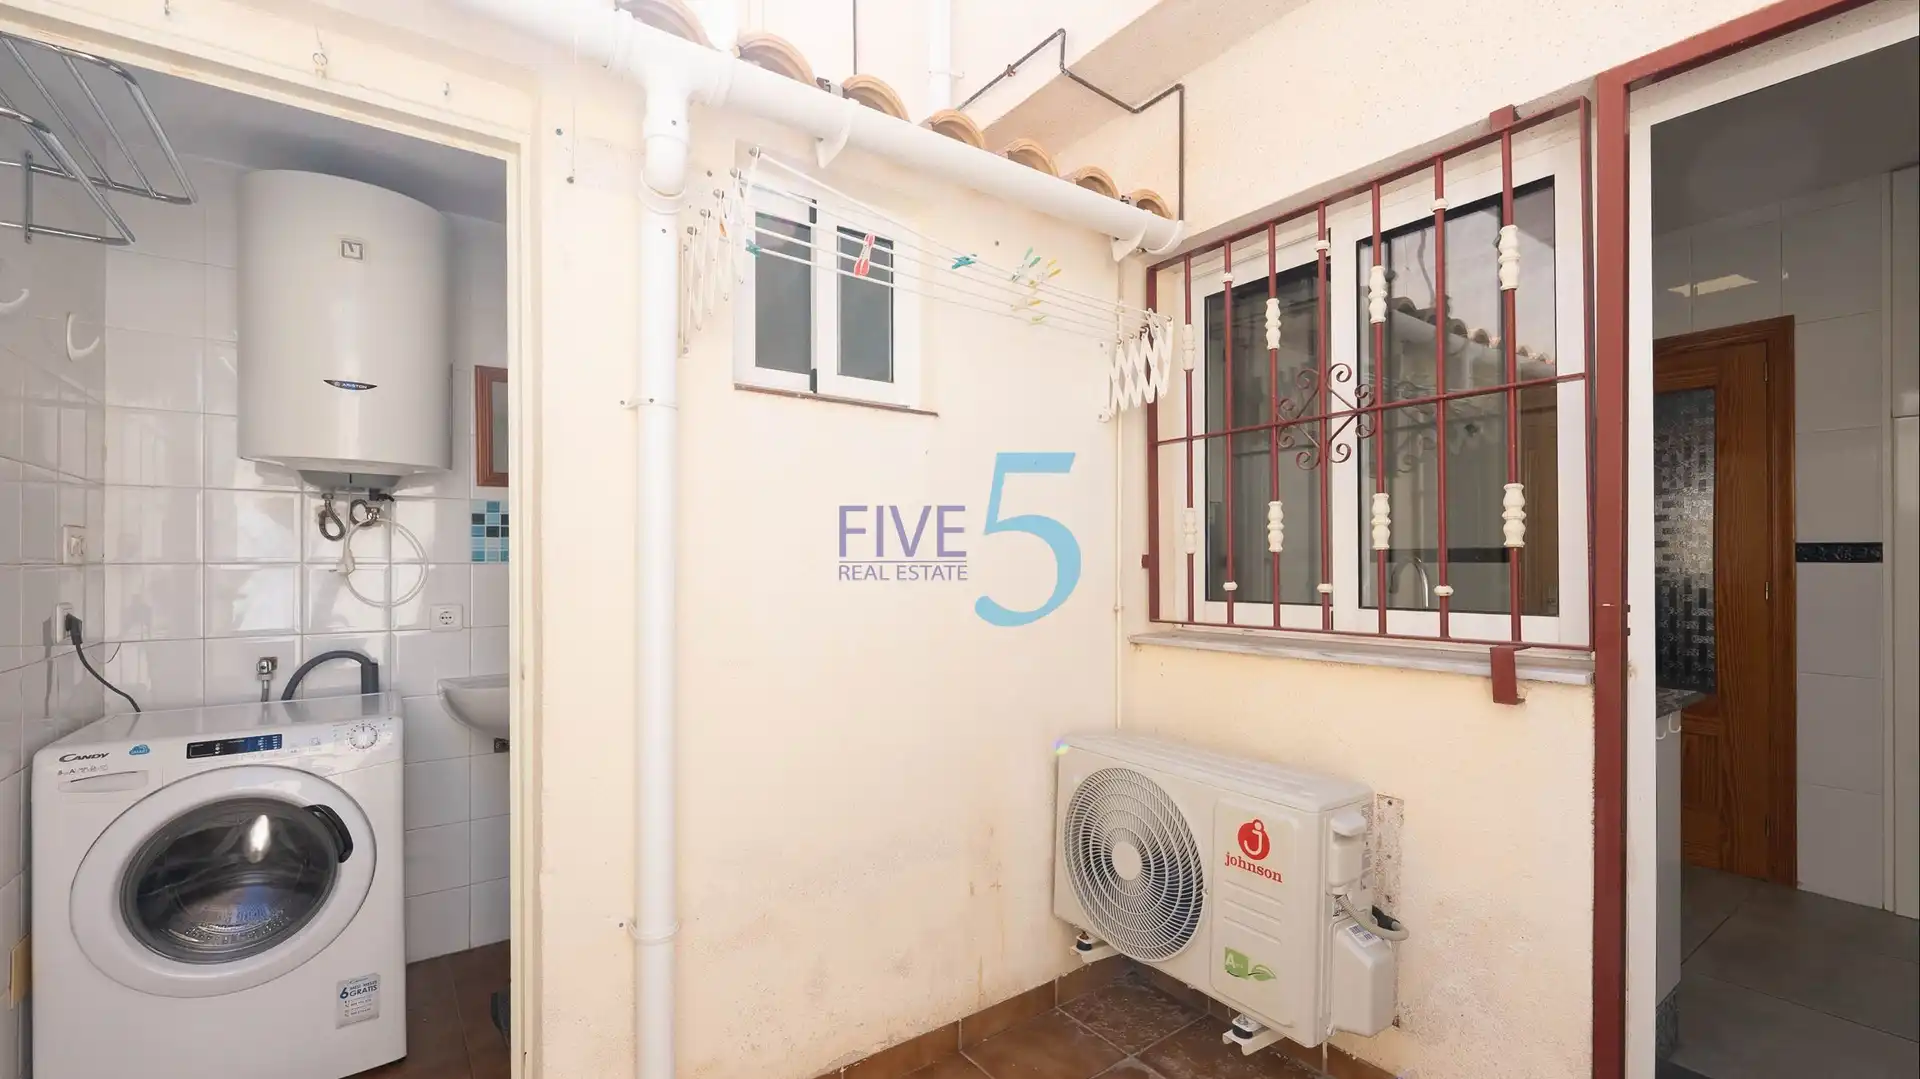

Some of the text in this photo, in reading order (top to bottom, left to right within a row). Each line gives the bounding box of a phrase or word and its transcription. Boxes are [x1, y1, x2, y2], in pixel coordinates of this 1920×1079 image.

[59, 752, 110, 763] CANDY
[1224, 852, 1283, 883] johnson
[339, 987, 349, 999] 6
[349, 984, 378, 997] GRATIS
